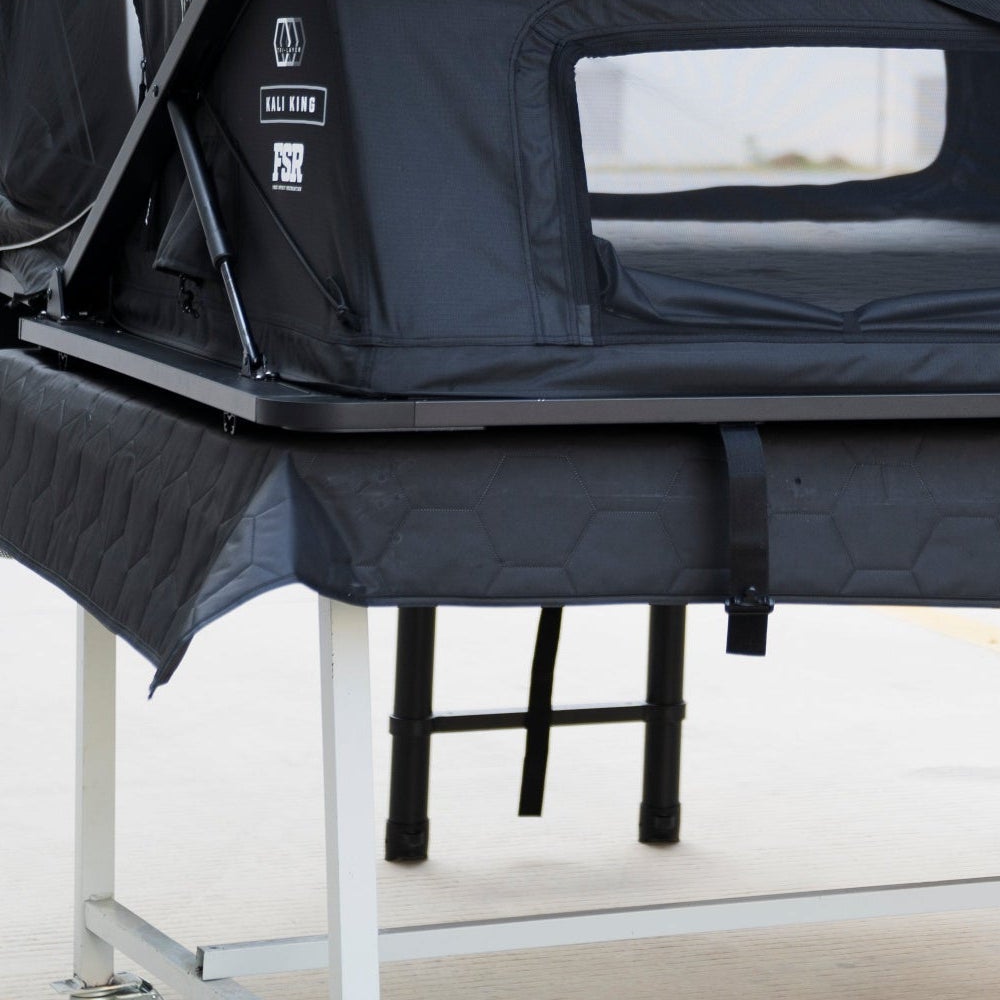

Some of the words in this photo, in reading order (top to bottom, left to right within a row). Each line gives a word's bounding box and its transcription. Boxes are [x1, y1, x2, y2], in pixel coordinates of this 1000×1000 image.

[265, 96, 285, 113] KALI
[289, 96, 316, 113] KING
[272, 142, 304, 182] FSR
